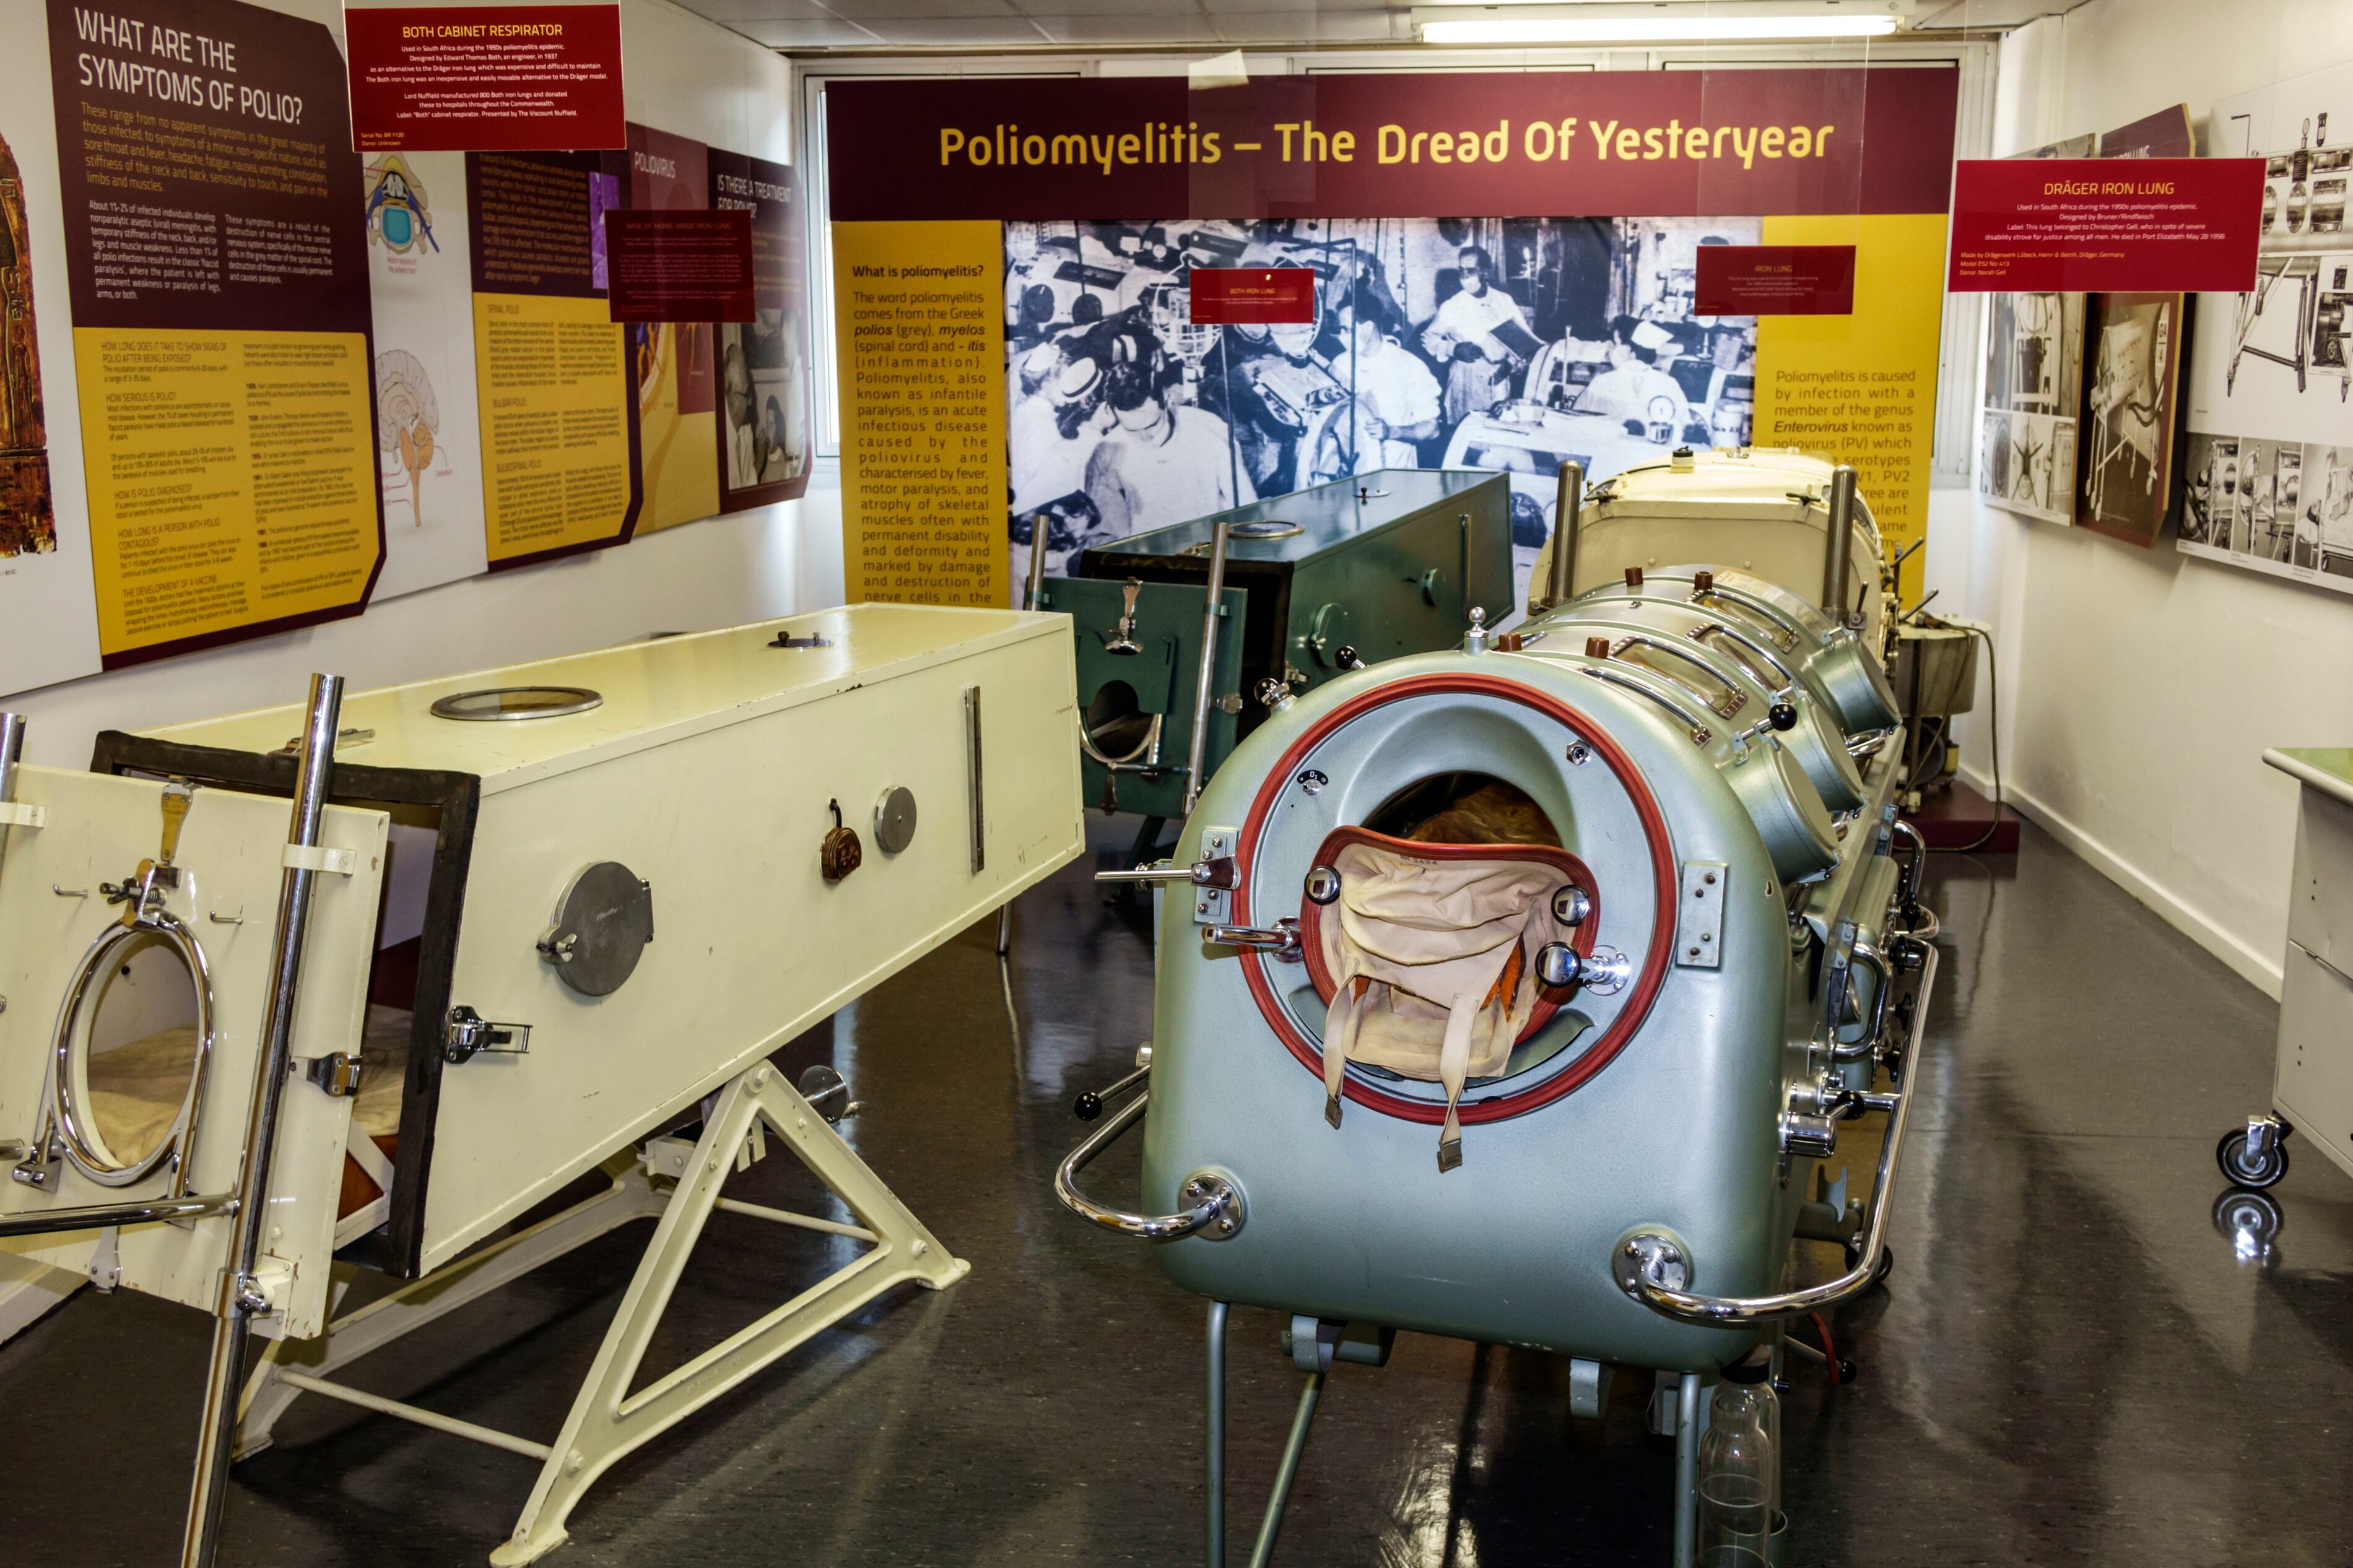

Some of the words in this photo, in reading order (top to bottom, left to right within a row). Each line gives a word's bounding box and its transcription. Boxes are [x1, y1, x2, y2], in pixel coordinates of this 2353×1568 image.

[402, 26, 434, 38] BOTH
[437, 25, 487, 37] CABINET
[489, 24, 563, 37] RESPIRATOR
[74, 6, 144, 52] WHAT
[151, 25, 193, 63] ARE
[196, 35, 237, 72] THE
[79, 53, 204, 106] SYMPTOMS
[209, 79, 235, 111] OF
[240, 86, 303, 124] POLIO?
[941, 123, 1222, 175] Poliomyelitis
[1274, 121, 1355, 163] The
[1378, 119, 1509, 164] Dread
[1524, 118, 1577, 162] Of
[1588, 119, 1834, 170] Yesteryear
[634, 151, 676, 179] POLIOVIRUS
[87, 170, 110, 186] limbs
[112, 175, 127, 188] and
[129, 177, 165, 192] muscles.
[718, 174, 724, 191] IS
[725, 175, 747, 196] THERE
[748, 181, 754, 197] A
[754, 181, 792, 203] TREATMENT
[2044, 180, 2098, 196] DRÄGER
[2102, 183, 2134, 195] IRON
[2138, 182, 2175, 195] LUNG
[852, 266, 885, 277] What
[888, 266, 898, 277] is
[902, 265, 984, 279] poliomyelitis?
[853, 292, 874, 303] The
[877, 292, 907, 303] word
[910, 292, 984, 305] poliomyelitis
[853, 310, 892, 319] comes
[895, 308, 924, 319] from
[928, 308, 947, 319] the
[950, 308, 984, 319] Greek
[854, 324, 892, 337] polios
[896, 324, 934, 338] (grey),
[939, 325, 985, 337] myelos
[855, 341, 895, 352] (spinal
[898, 341, 928, 352] cord)
[932, 341, 955, 352] and
[967, 342, 985, 351] itis
[855, 356, 985, 368] (inflammation).
[856, 373, 949, 386] Poliomyelitis,
[958, 373, 986, 384] also
[1777, 370, 1855, 385] Poliomyelitis
[1858, 371, 1868, 383] is
[1871, 370, 1916, 383] caused
[857, 389, 900, 399] known
[908, 390, 923, 399] as
[931, 389, 986, 399] infantile
[1775, 388, 1791, 402] by
[1799, 387, 1860, 399] infection
[1869, 387, 1899, 399] with
[1907, 389, 1914, 399] a
[858, 405, 915, 417] paralysis,
[919, 405, 929, 415] is
[933, 406, 948, 415] an
[953, 405, 986, 416] acute
[1775, 404, 1829, 416] member
[1833, 404, 1845, 415] of
[1850, 404, 1871, 415] the
[1874, 406, 1913, 418] genus
[858, 420, 926, 431] infectious
[935, 421, 987, 431] disease
[1773, 421, 1848, 433] Enterovirus
[1851, 420, 1894, 432] known
[1898, 422, 1912, 432] as
[858, 436, 911, 448] caused
[929, 436, 946, 449] by
[963, 436, 988, 448] the
[1773, 438, 1836, 449] poliovirus
[1841, 437, 1868, 451] (PV)
[1873, 436, 1911, 449] which
[859, 453, 941, 464] poliovirus
[960, 453, 988, 463] and
[1844, 456, 1911, 467] serotypes
[859, 468, 937, 479] characterised
[940, 468, 953, 481] by
[957, 468, 988, 480] fever,
[1857, 470, 1877, 483] V1,
[1884, 470, 1910, 482] PV2
[861, 484, 897, 494] motor
[903, 483, 961, 496] paralysis,
[965, 485, 988, 495] and
[1862, 489, 1885, 498] ree
[861, 500, 911, 511] atrophy
[918, 500, 931, 510] of
[938, 500, 989, 510] skeletal
[1872, 504, 1907, 515] ulent
[861, 515, 913, 525] muscles
[920, 514, 954, 526] often
[961, 515, 989, 526] with
[863, 531, 929, 542] permanent
[934, 530, 989, 544] disability
[863, 546, 886, 555] and
[894, 545, 958, 559] deformity
[966, 547, 989, 557] and
[863, 561, 911, 571] marked
[918, 561, 933, 574] by
[940, 561, 990, 574] damage
[864, 576, 887, 586] and
[895, 577, 970, 587] destruction
[978, 577, 990, 587] of
[864, 593, 901, 602] nerve
[910, 592, 939, 602] cells
[949, 592, 960, 602] in
[970, 592, 991, 603] the
